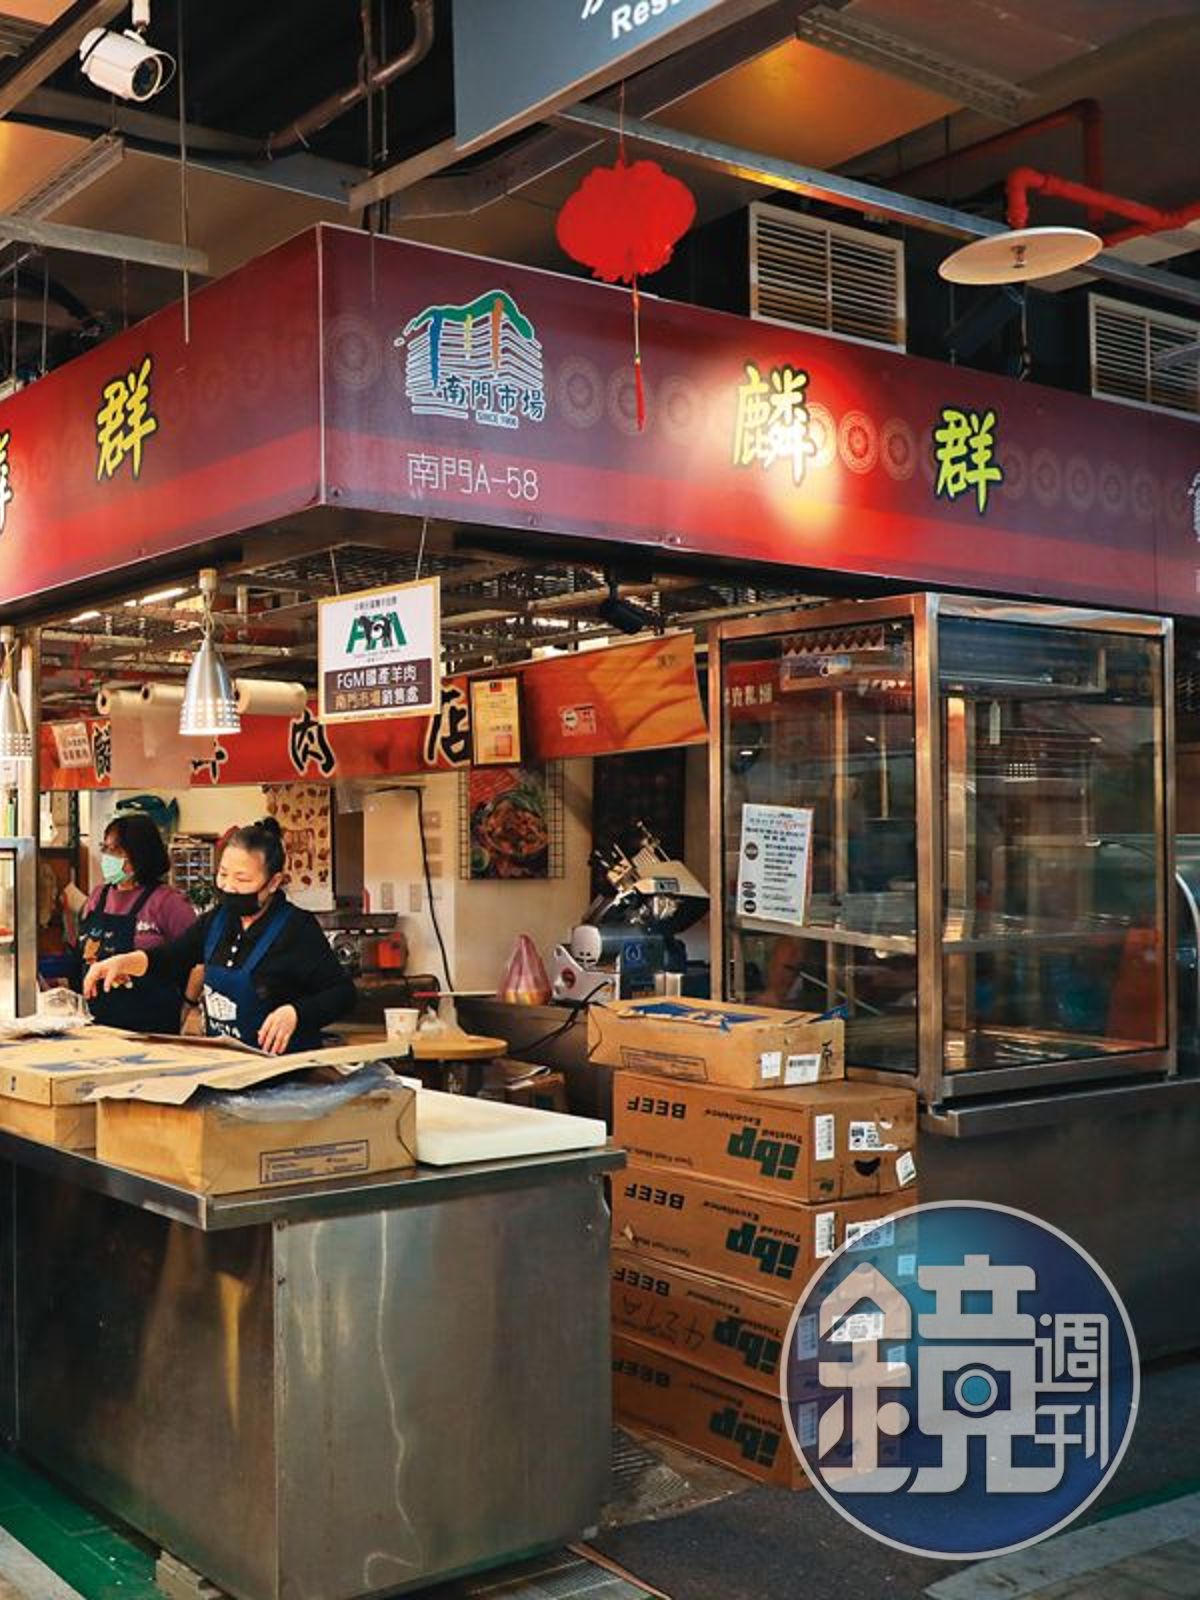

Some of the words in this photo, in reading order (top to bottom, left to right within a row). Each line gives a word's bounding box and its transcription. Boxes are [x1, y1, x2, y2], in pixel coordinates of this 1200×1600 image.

[611, 0, 680, 39] Res
[443, 375, 545, 421] 南門市場
[407, 453, 539, 501] 南門A-58
[626, 1096, 686, 1120] BEEF
[727, 1126, 800, 1181] ibp
[762, 1128, 804, 1144] Trusted
[624, 1183, 685, 1210] BEEF
[725, 1222, 800, 1280] ibp
[613, 1267, 670, 1297] BEEF
[713, 1317, 782, 1375] ibp
